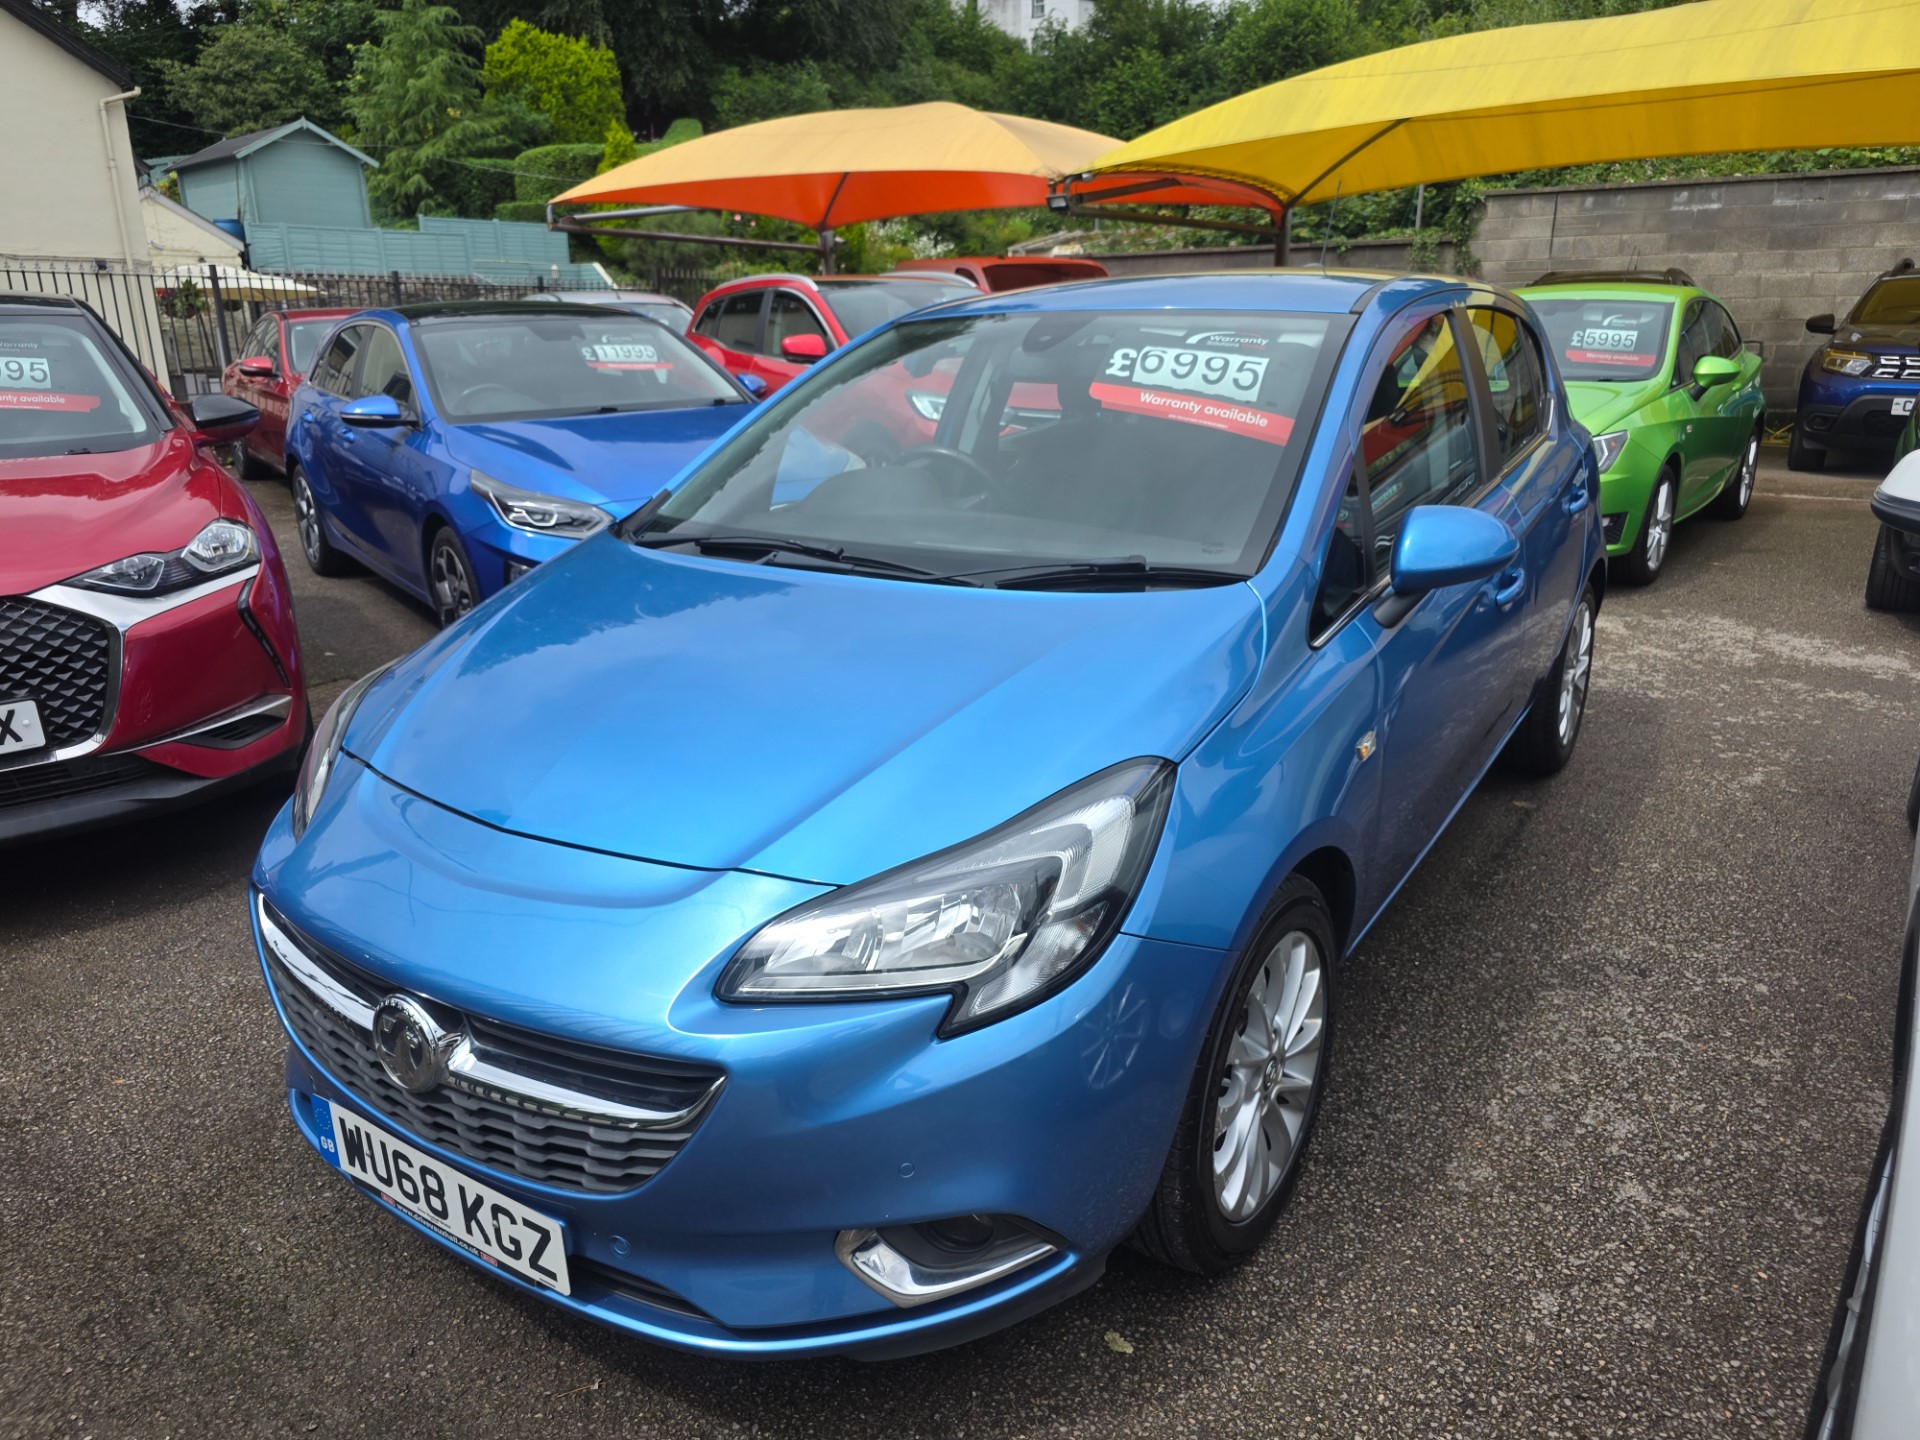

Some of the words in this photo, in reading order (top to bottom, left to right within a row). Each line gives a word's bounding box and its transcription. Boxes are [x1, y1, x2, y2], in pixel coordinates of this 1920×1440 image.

[1210, 335, 1269, 346] Warranty
[1571, 331, 1635, 348] £5995
[582, 345, 655, 361] £11995
[0, 360, 48, 383] 95
[1105, 348, 1263, 392] £6995
[20, 395, 65, 403] available
[1140, 392, 1202, 414] Warranty
[1204, 405, 1268, 427] available
[320, 1136, 335, 1153] GB
[339, 1116, 449, 1221] WU68
[458, 1183, 558, 1282] KGZ
